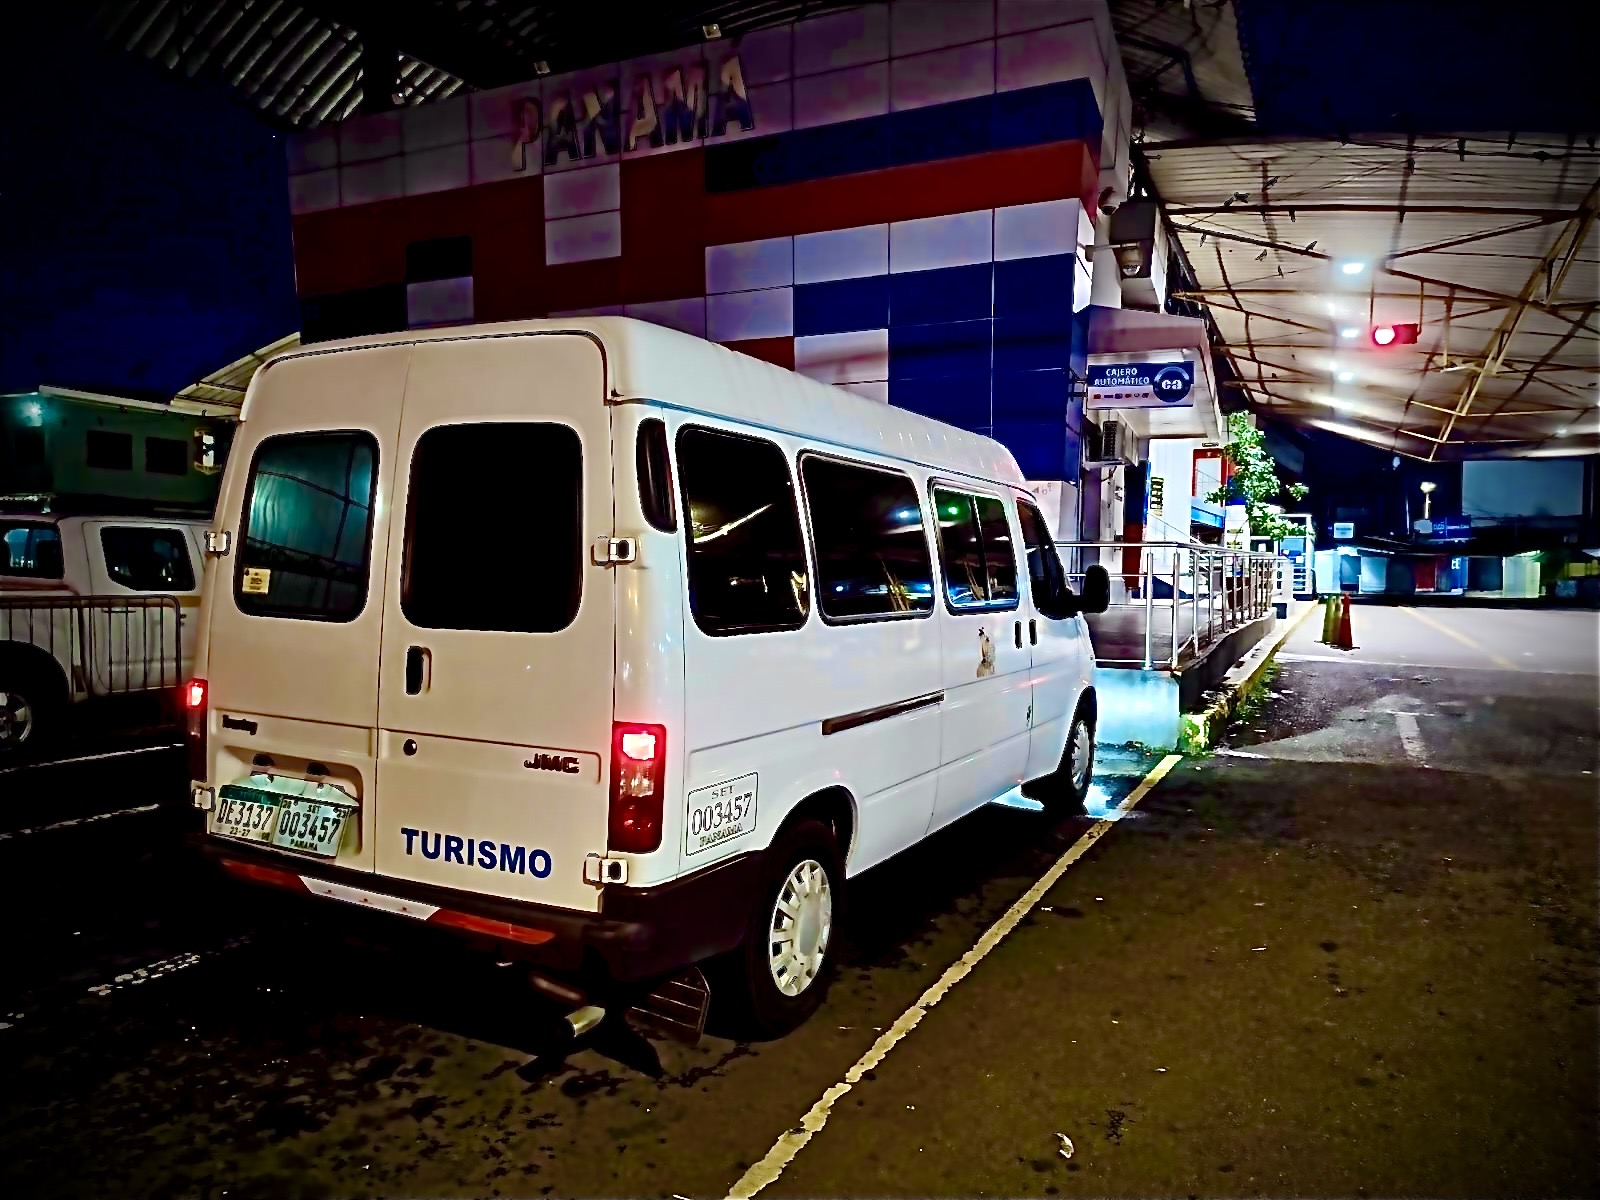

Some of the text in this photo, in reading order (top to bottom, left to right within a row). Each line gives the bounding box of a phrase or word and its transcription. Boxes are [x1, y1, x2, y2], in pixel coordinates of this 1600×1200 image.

[511, 55, 755, 172] PANAMA
[1094, 376, 1150, 386] AUTOMÁTICO
[1105, 367, 1138, 377] CAJERO
[523, 753, 580, 774] JMC
[711, 784, 735, 800] SET
[216, 798, 275, 831] DE3137
[278, 809, 342, 845] 003457
[691, 791, 753, 836] 003457
[699, 822, 744, 848] PANAMA
[400, 826, 553, 879] TURISMO
